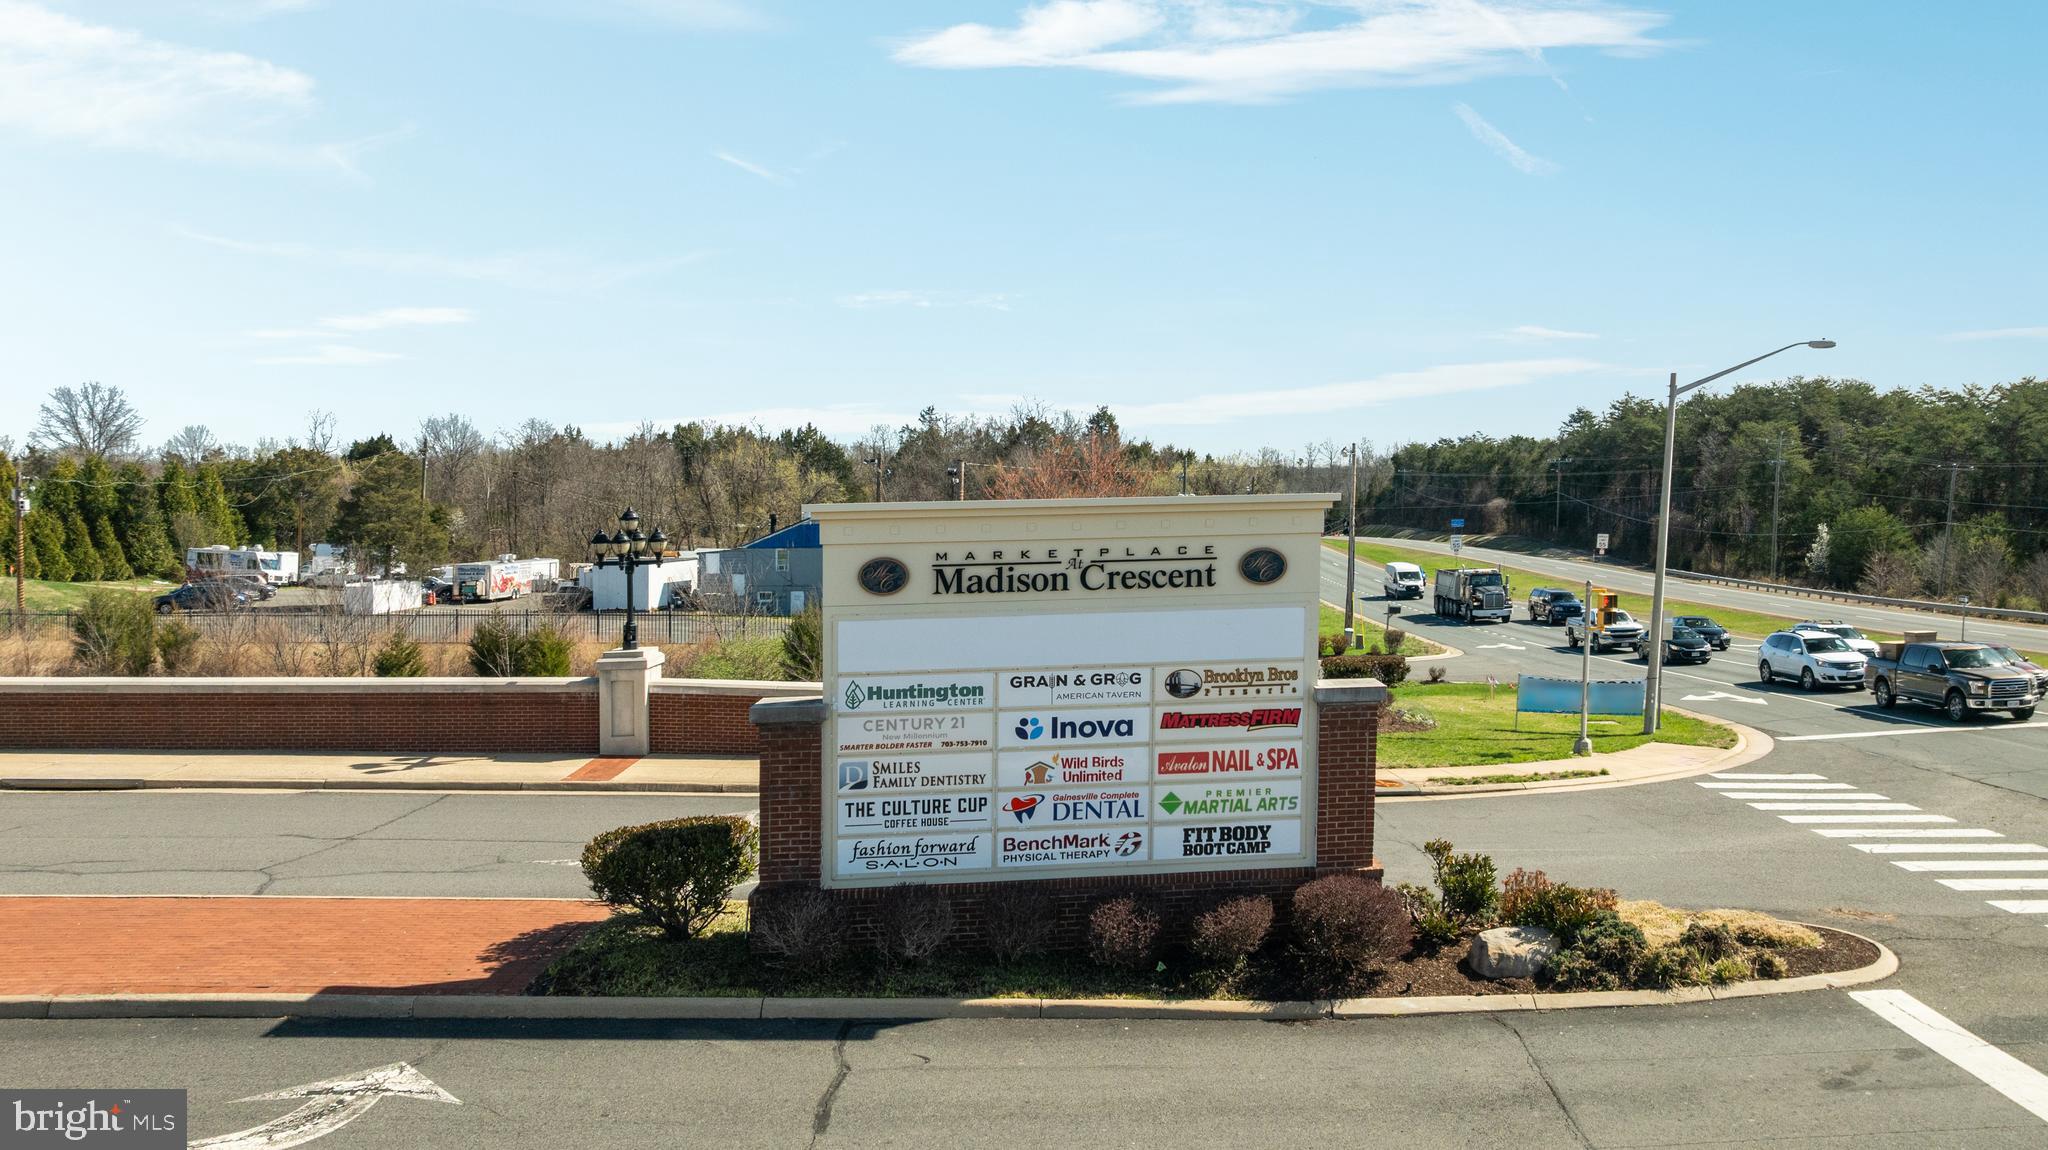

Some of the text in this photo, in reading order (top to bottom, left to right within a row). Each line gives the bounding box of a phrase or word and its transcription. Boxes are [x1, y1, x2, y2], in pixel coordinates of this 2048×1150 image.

[935, 546, 1214, 561] MARKETPLACE
[1065, 558, 1084, 570] At
[932, 563, 1217, 595] Madison Crescent
[1073, 674, 1086, 687] &
[1203, 667, 1299, 686] Brooklyn Bros
[867, 683, 984, 702] Huntington
[1056, 693, 1104, 701] AMERICAN
[883, 698, 984, 709] LEARNING CENTER
[863, 716, 965, 732] CENTURY 21
[1051, 716, 1134, 739] Inova
[903, 732, 948, 740] Millennium
[906, 741, 933, 749] FASTER
[940, 740, 988, 748] 703-753-7910
[1060, 756, 1125, 770] Wild Birds
[1160, 747, 1299, 773] Avalon NAIL & SPA
[1062, 769, 1123, 783] Unlimited
[1052, 791, 1140, 802] Gainesville Complete
[1205, 787, 1272, 798] PREMIER
[845, 797, 988, 818] THE CULTURE CUP
[1053, 800, 1145, 821] DENTAL
[1183, 796, 1299, 815] MARTIAL ARTS
[884, 817, 949, 829] COFFEE HOUSE
[1182, 825, 1272, 843] FIT BODY
[848, 835, 980, 864] fashion forward
[1003, 833, 1110, 853] BenchMark
[1003, 849, 1110, 863] PHYSICAL THERAPY
